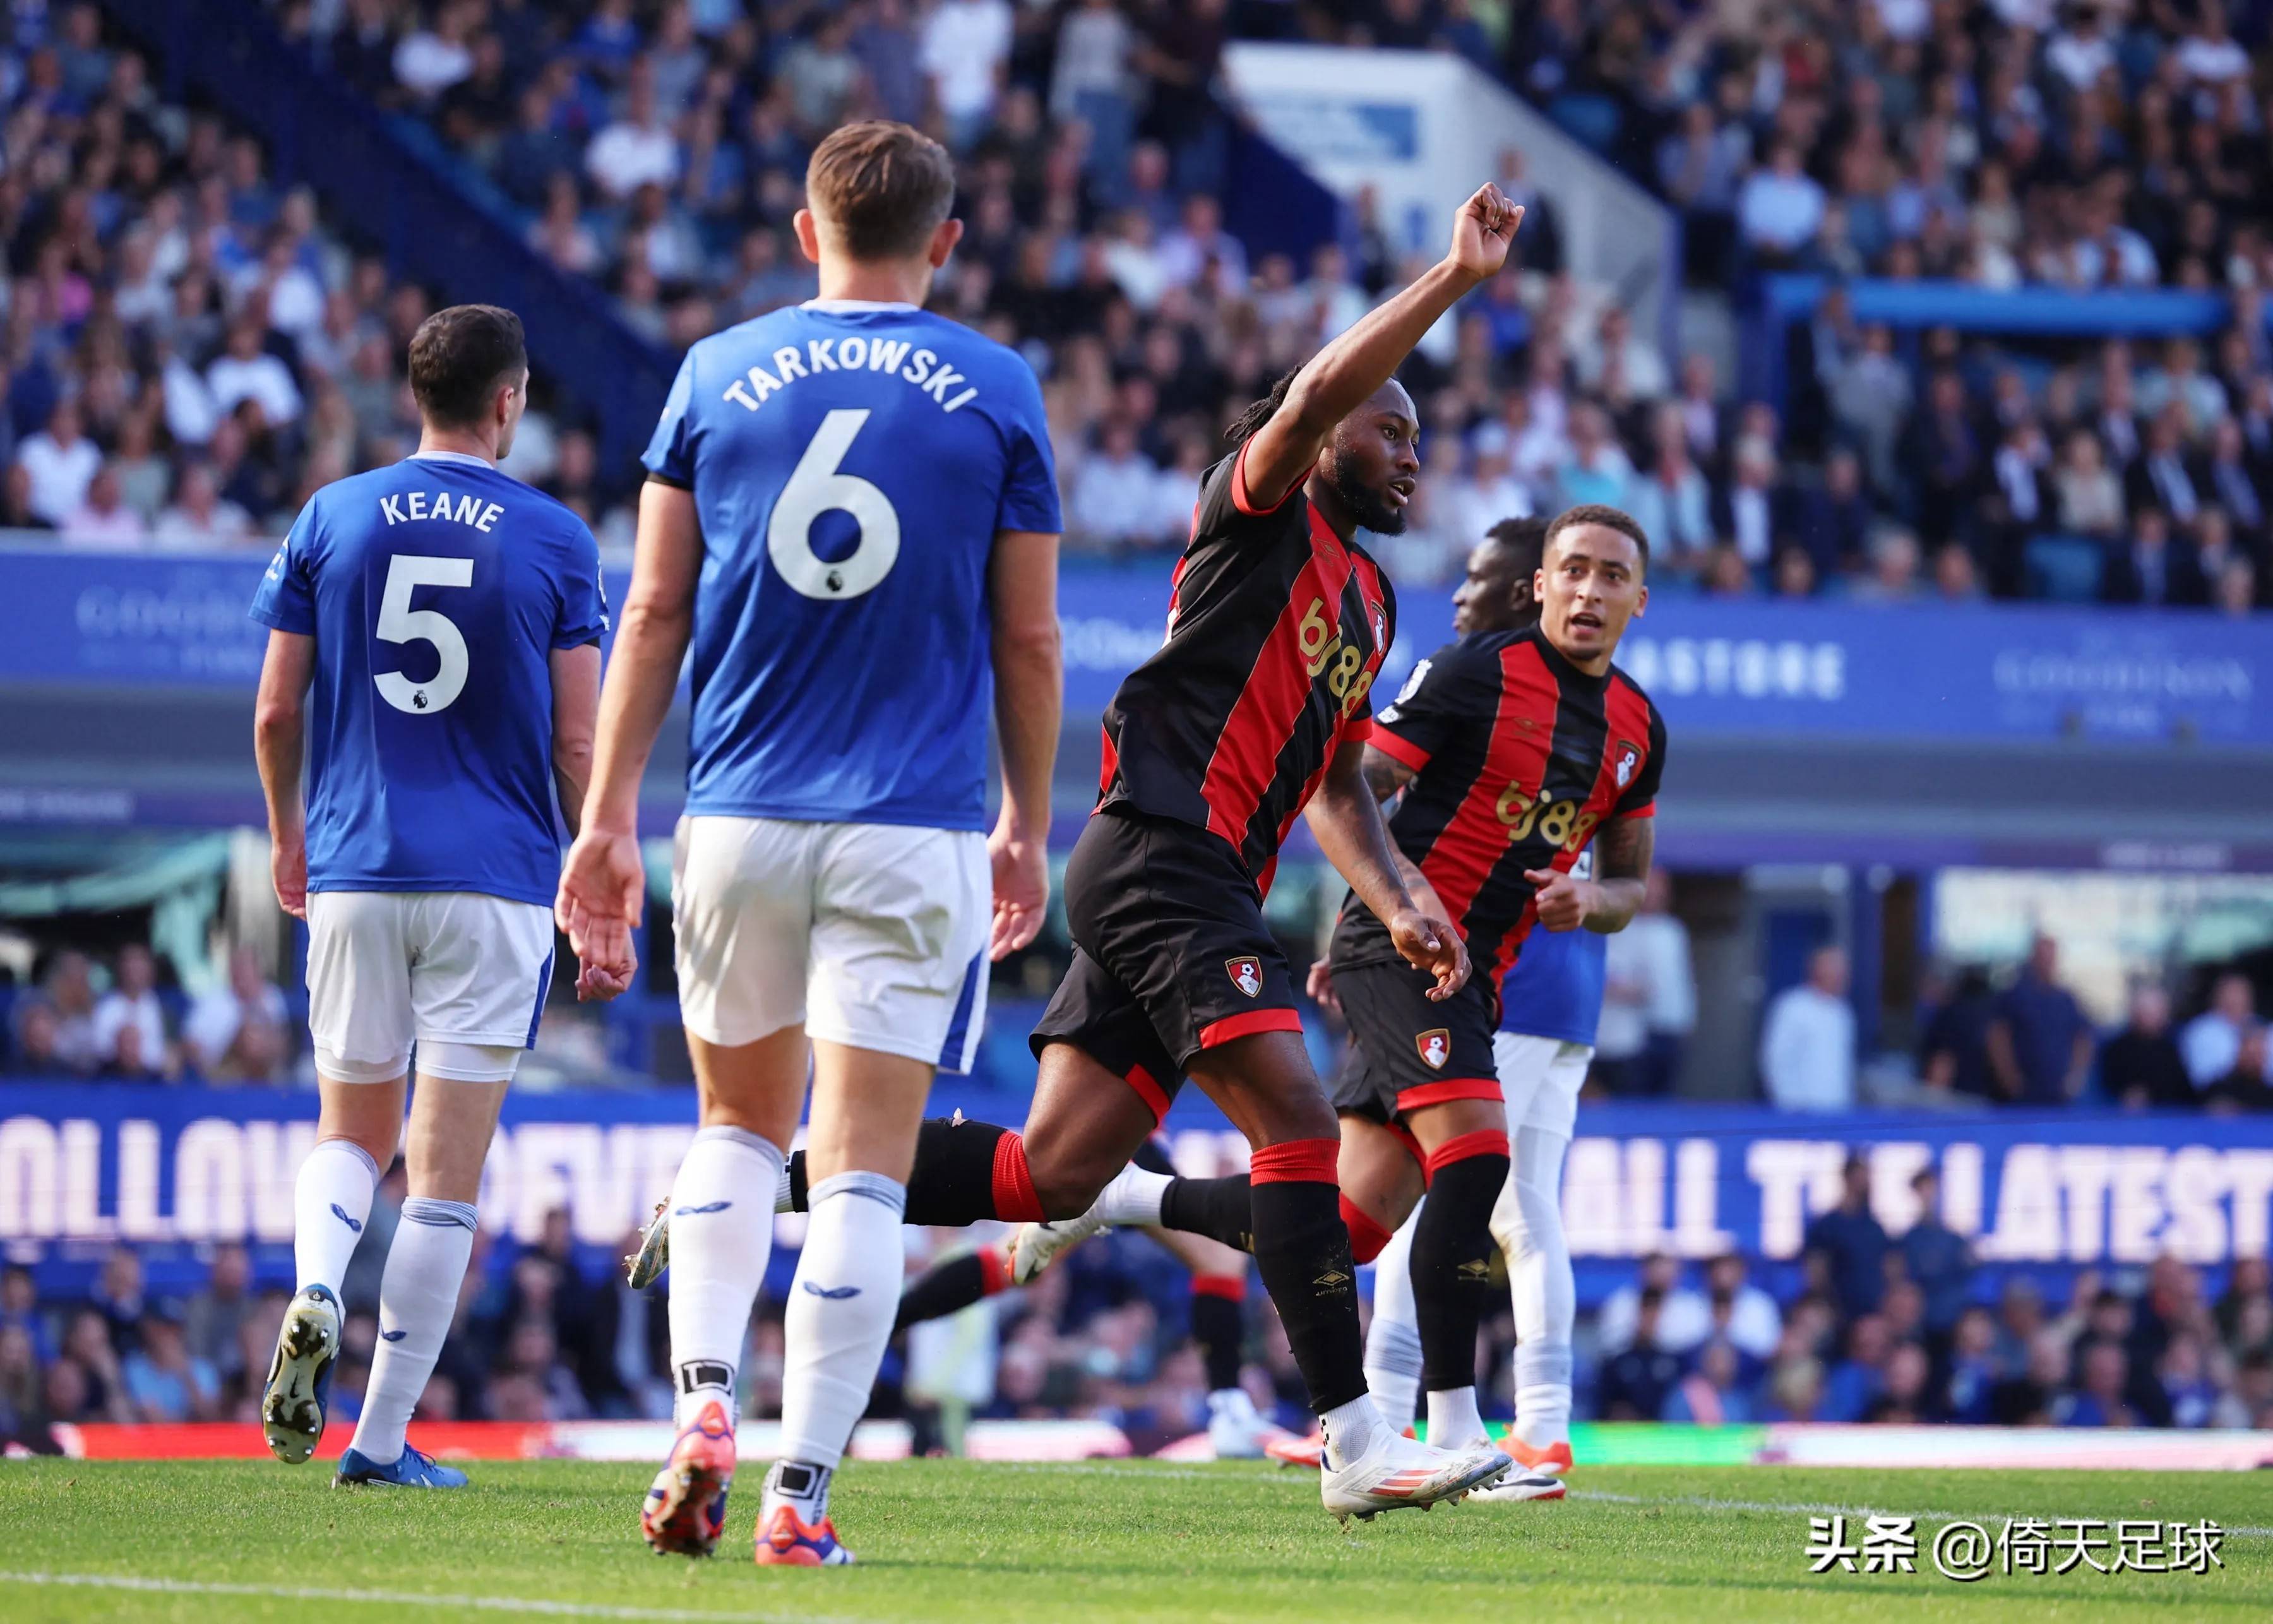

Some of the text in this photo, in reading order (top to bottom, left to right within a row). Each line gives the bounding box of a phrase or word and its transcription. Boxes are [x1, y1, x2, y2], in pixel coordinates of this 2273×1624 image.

[722, 337, 978, 413] TARKOWSKI
[379, 491, 504, 533] KEANE
[767, 408, 900, 600] 6
[373, 553, 474, 714] 5
[1299, 596, 1373, 719] bj88
[1495, 779, 1598, 853] bj88
